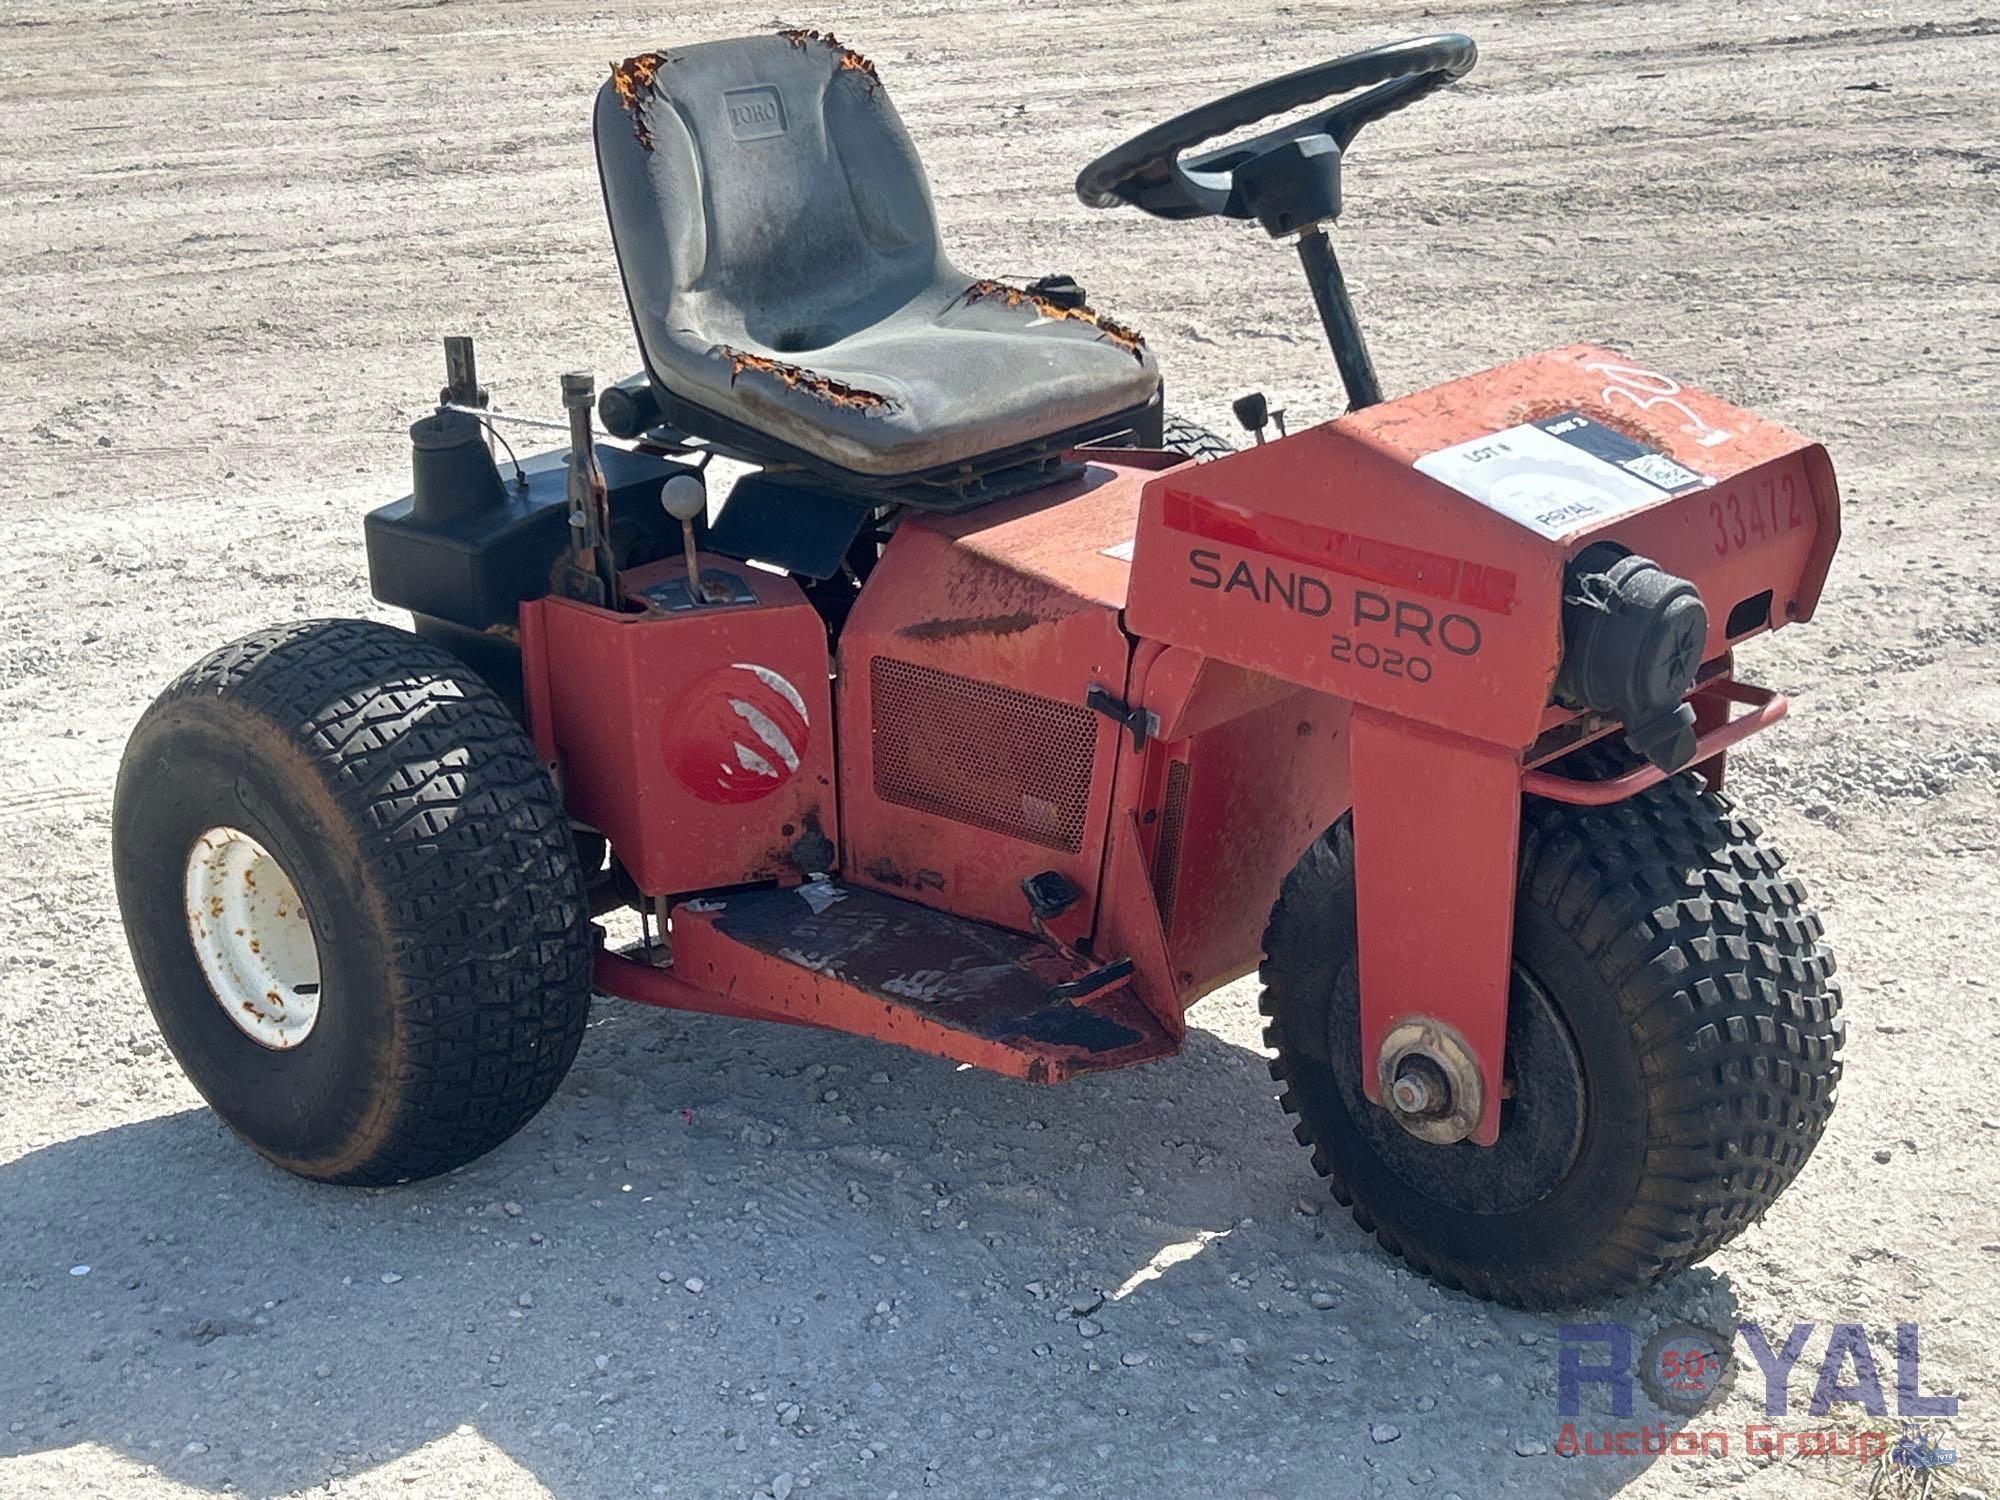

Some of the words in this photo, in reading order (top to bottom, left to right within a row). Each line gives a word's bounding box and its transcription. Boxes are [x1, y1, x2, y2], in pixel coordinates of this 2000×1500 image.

[731, 101, 777, 126] TORO
[1462, 445, 1500, 464] LOT
[1708, 472, 1803, 557] 33472
[1188, 549, 1333, 617] SAND
[1354, 590, 1482, 656] PRO
[1331, 634, 1433, 683] 2020
